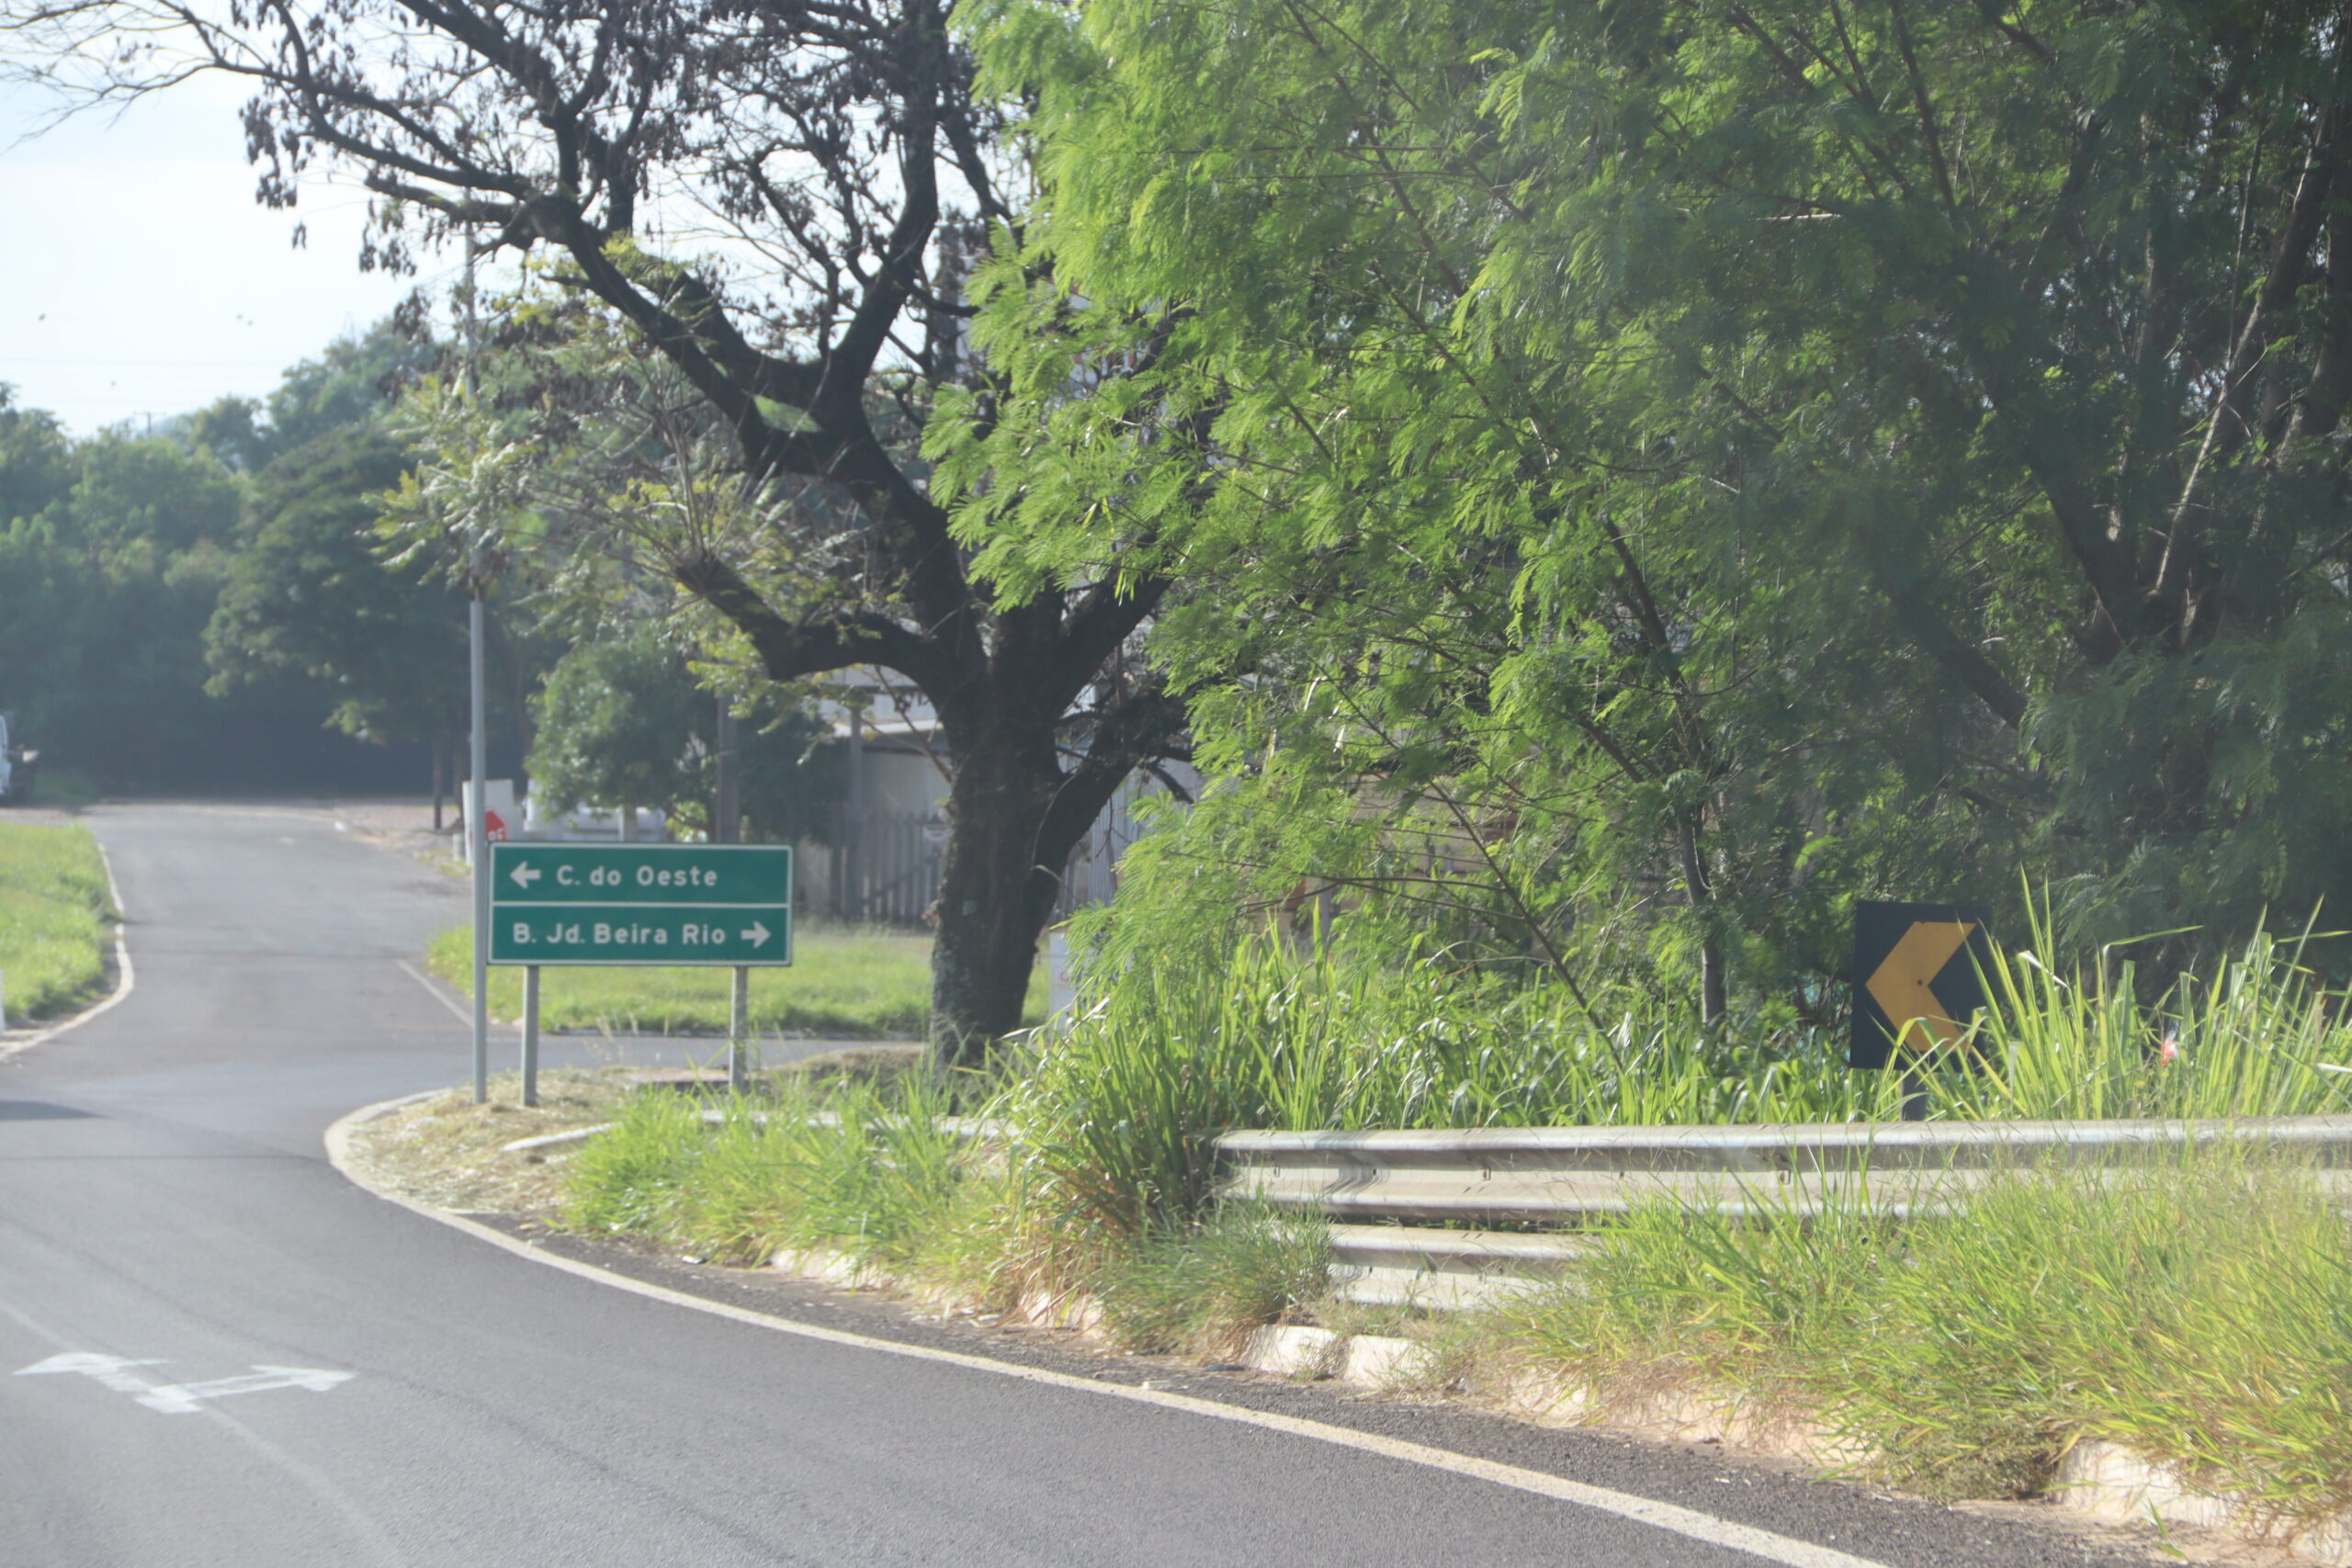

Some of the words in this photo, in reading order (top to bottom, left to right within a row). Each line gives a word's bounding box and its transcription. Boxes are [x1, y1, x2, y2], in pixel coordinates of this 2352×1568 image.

[557, 864, 581, 886] C.
[590, 865, 621, 886] do
[637, 865, 718, 886] Oeste
[514, 922, 537, 943] B.
[547, 922, 585, 943] Jd.
[594, 922, 667, 944] Beira
[683, 923, 726, 944] Rio
